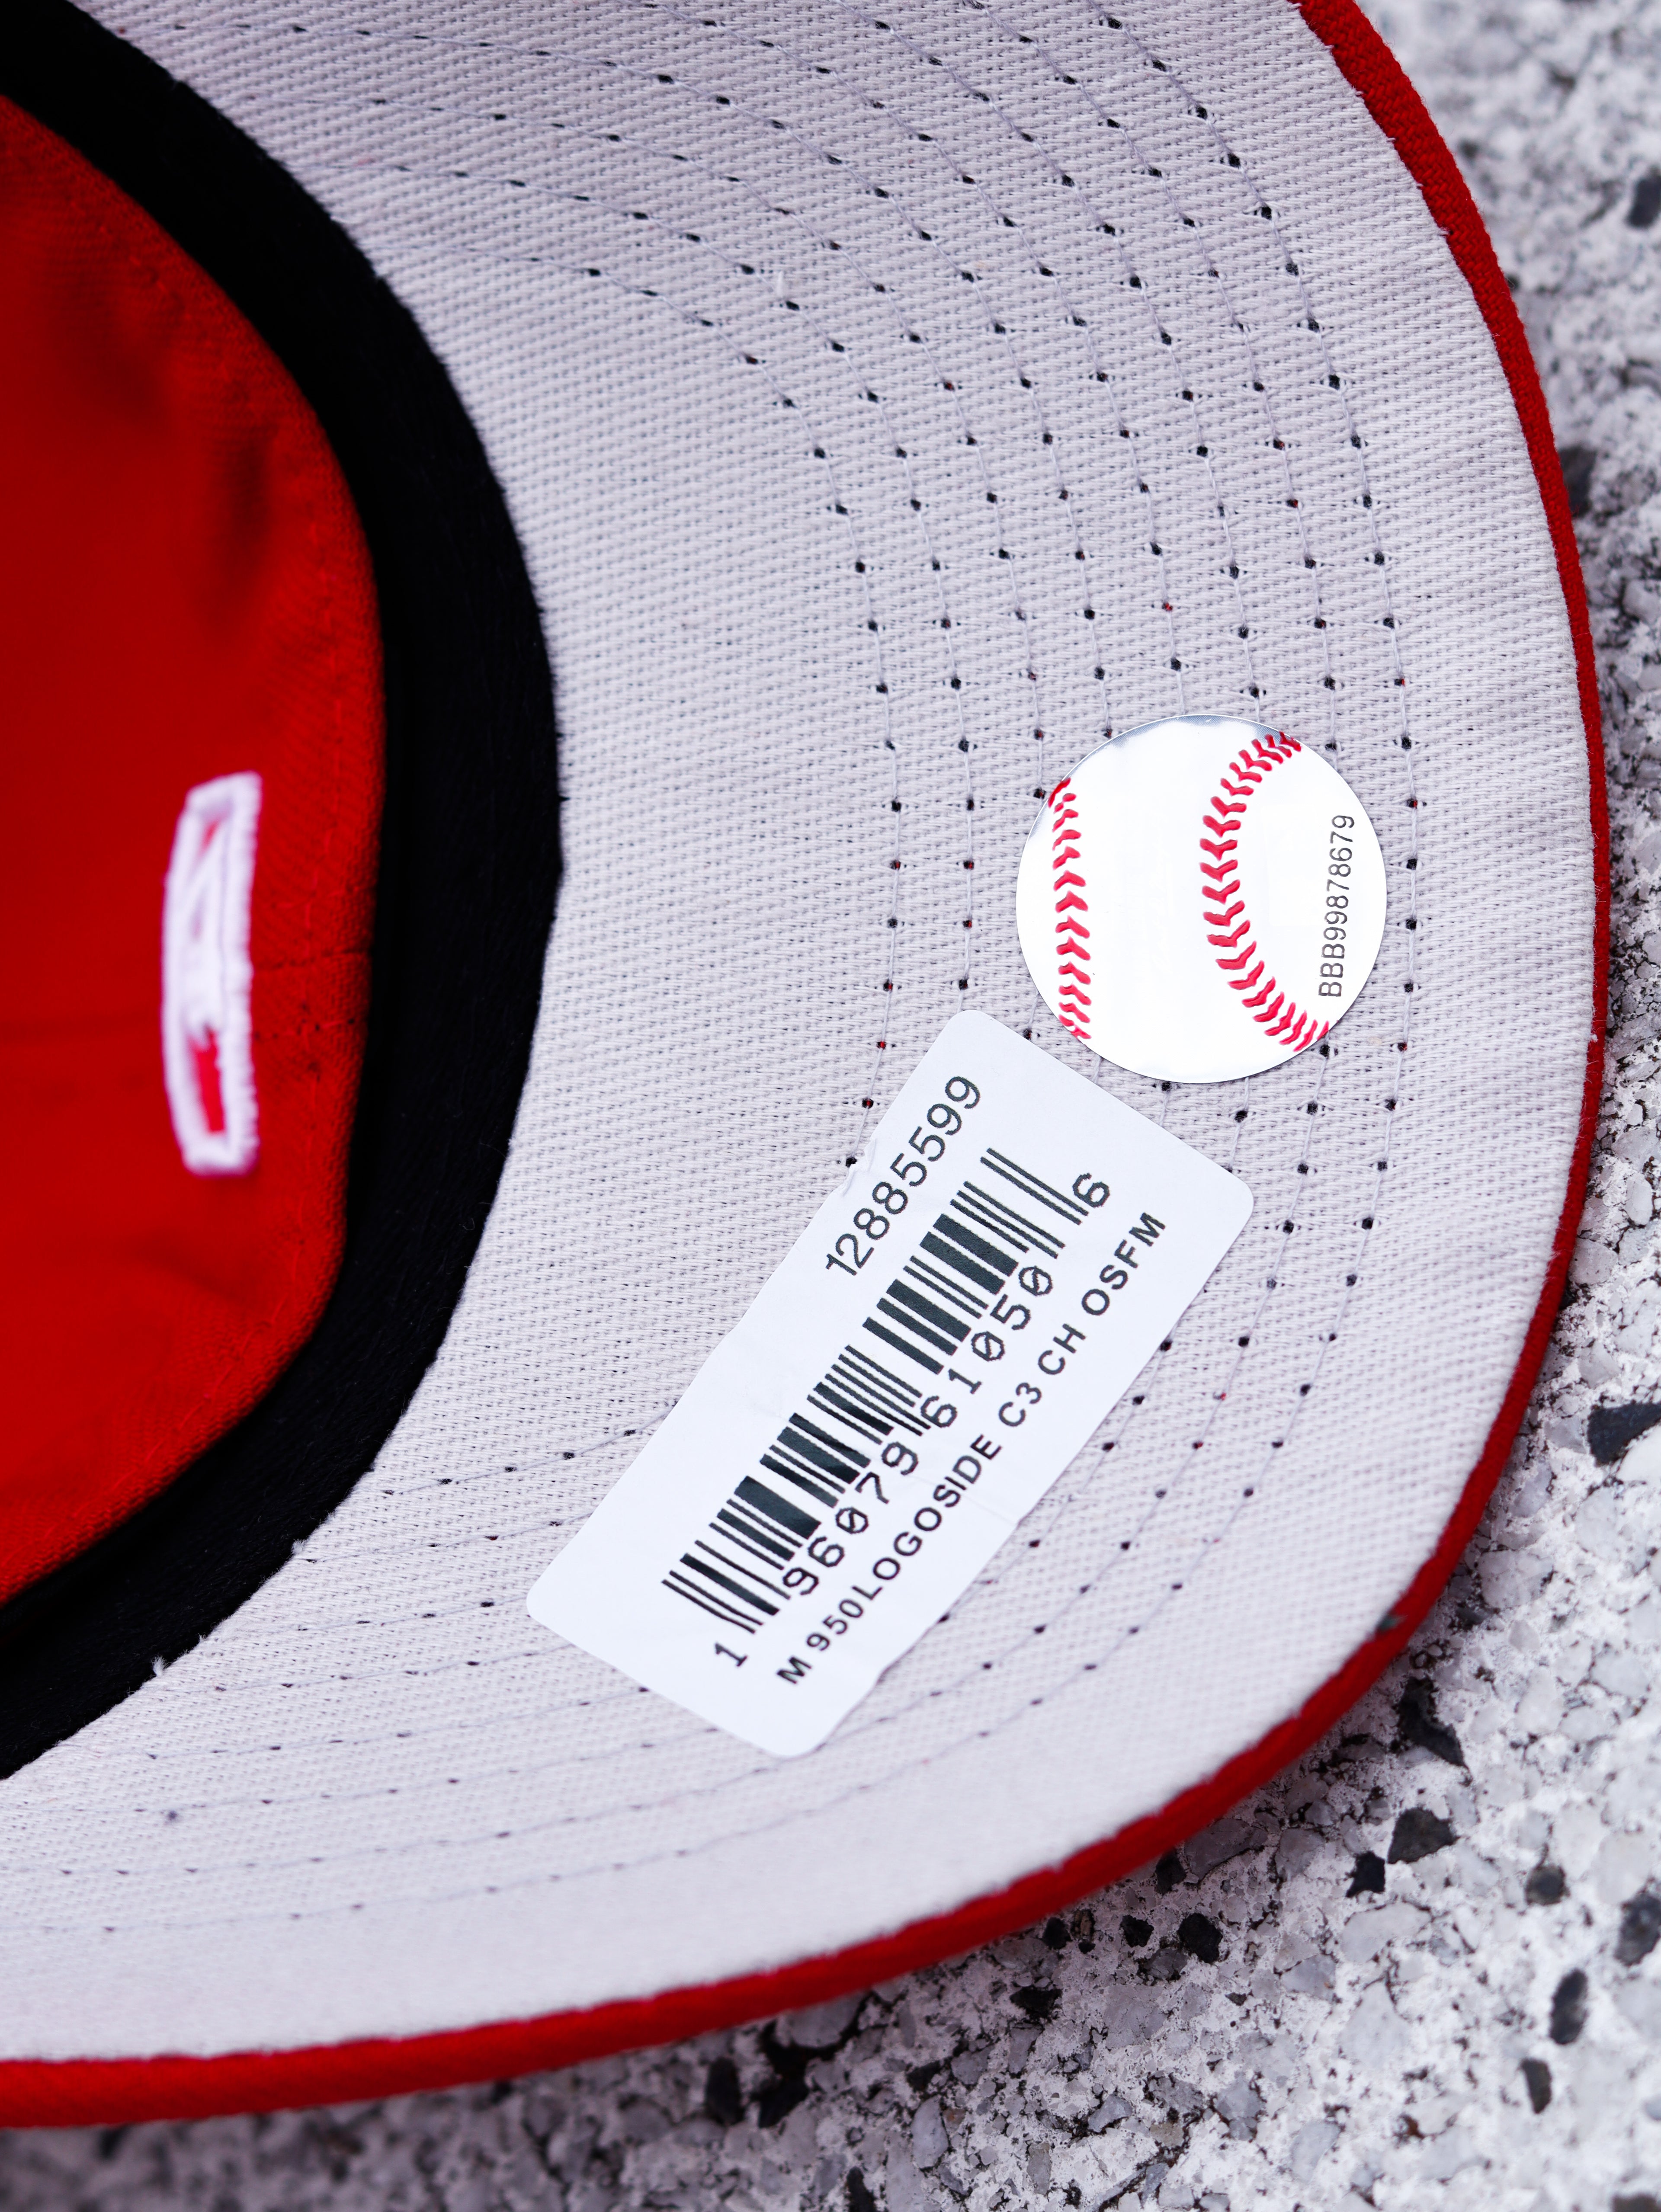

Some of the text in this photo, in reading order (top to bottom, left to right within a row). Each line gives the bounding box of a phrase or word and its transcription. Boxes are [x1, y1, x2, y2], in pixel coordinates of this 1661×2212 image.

[1319, 815, 1354, 998] BBB99878679
[826, 1076, 981, 1276] 12885599
[776, 1656, 811, 1684] M
[998, 1383, 1042, 1427] C3
[1038, 1324, 1086, 1375] CH
[1081, 1212, 1165, 1316] OSFM
